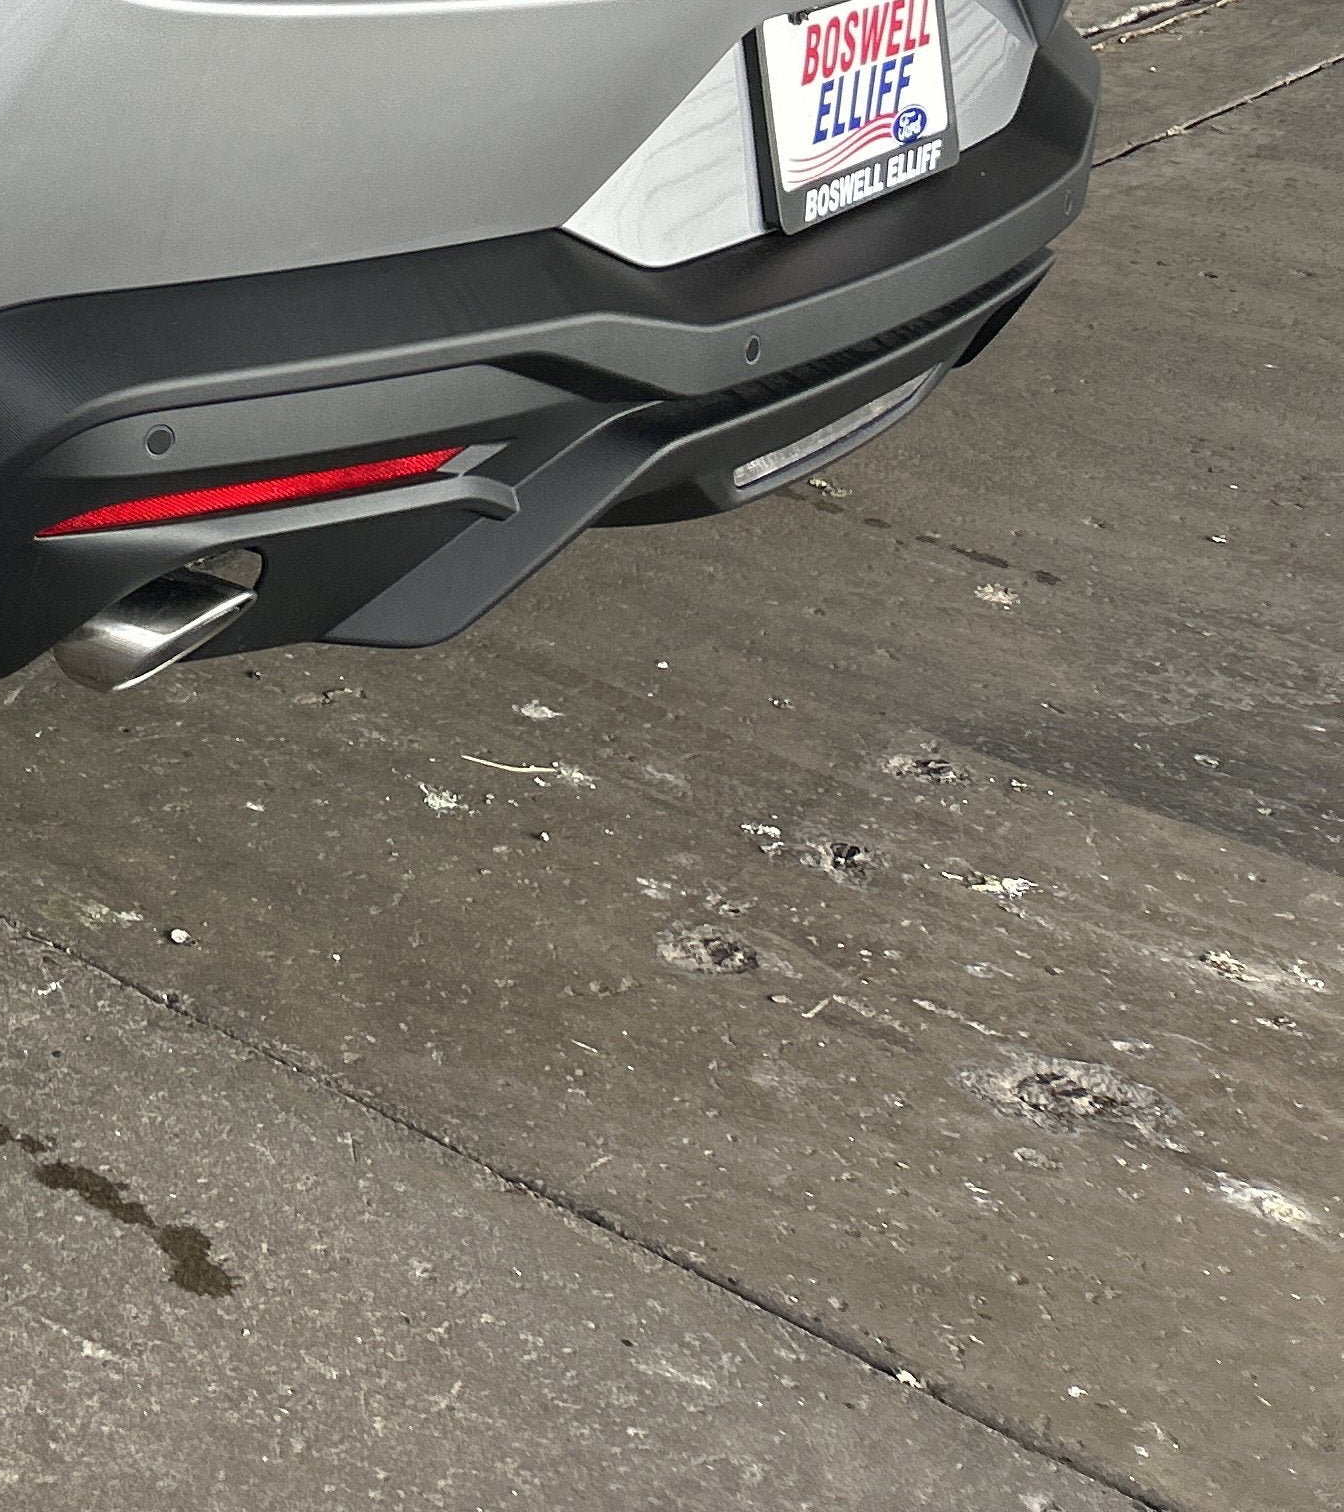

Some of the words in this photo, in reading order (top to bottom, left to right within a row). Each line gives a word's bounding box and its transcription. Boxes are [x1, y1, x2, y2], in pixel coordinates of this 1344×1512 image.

[812, 53, 915, 146] ELLIFF
[804, 164, 884, 223] BOSWELL
[886, 139, 943, 189] ELLIFF
